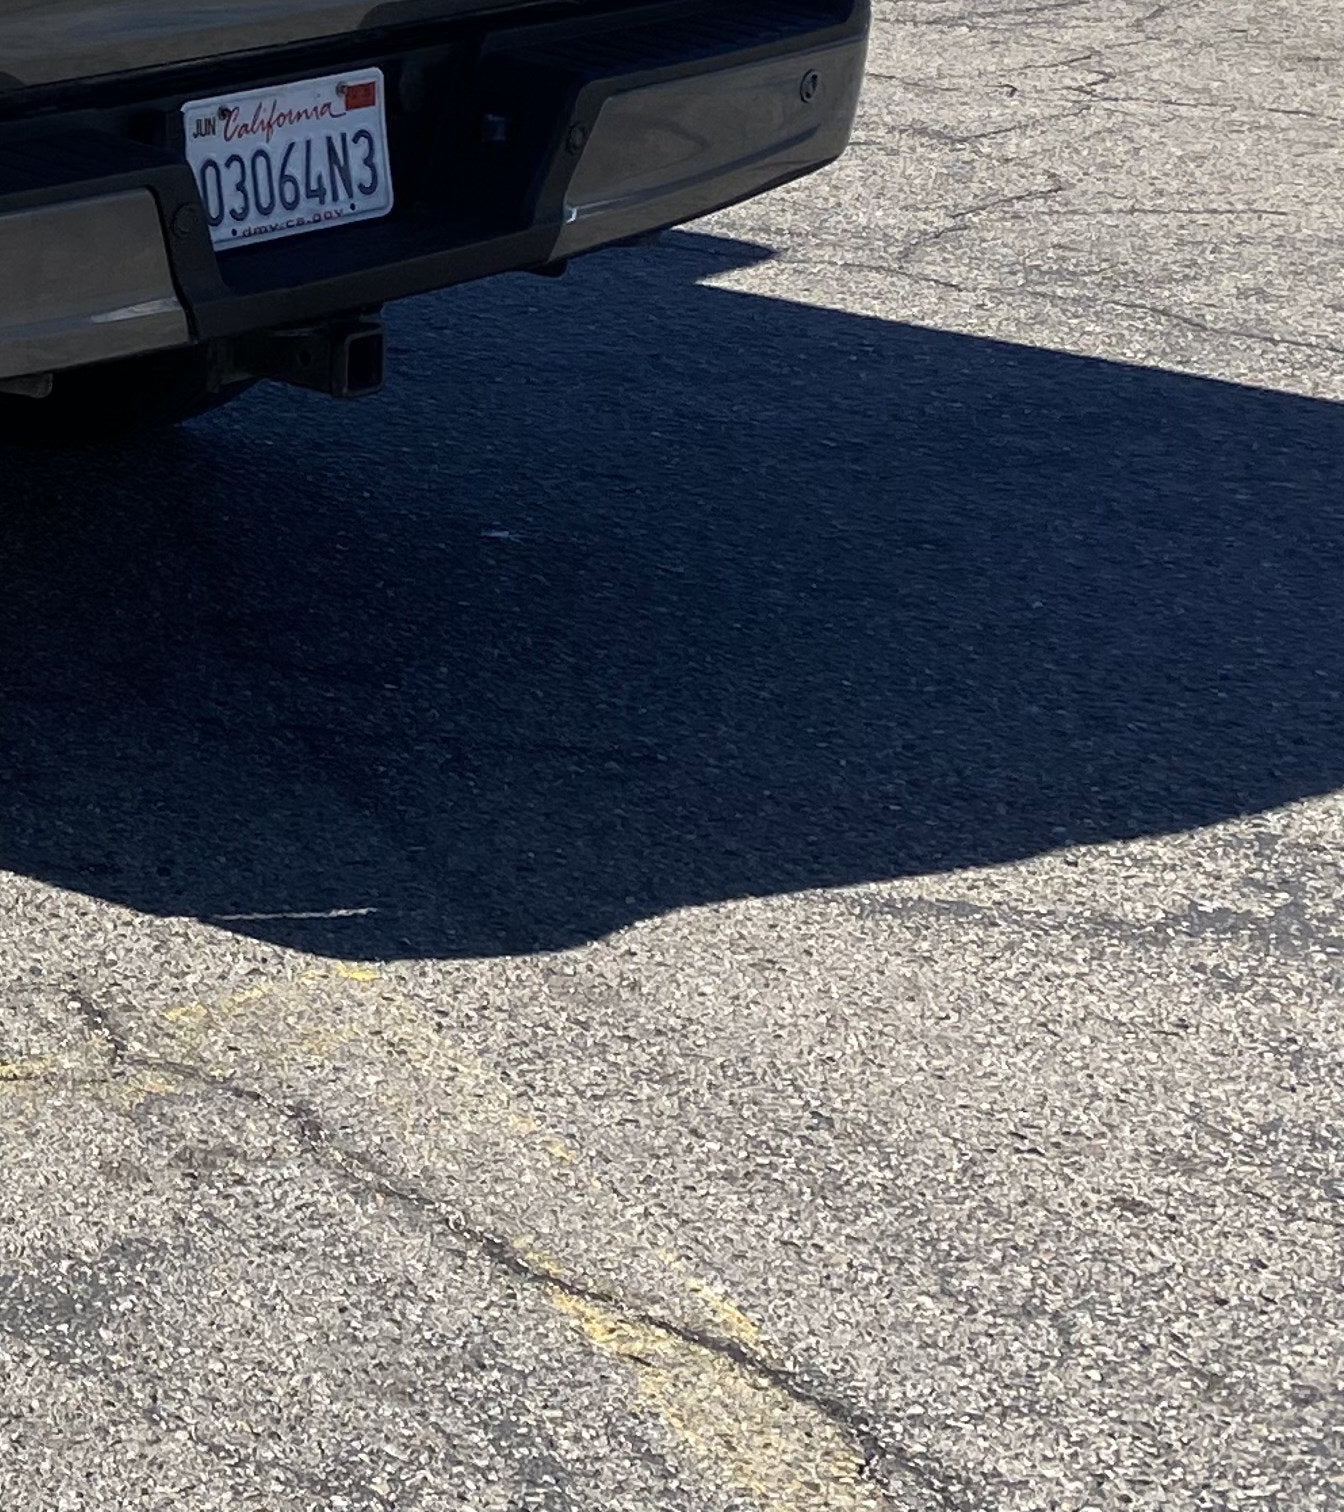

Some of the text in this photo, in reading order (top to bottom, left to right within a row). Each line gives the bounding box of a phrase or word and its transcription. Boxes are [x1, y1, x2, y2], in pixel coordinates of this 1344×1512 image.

[193, 100, 346, 143] JUN California
[199, 129, 379, 227] 03064N3
[241, 209, 345, 238] dmv.ca.gov
